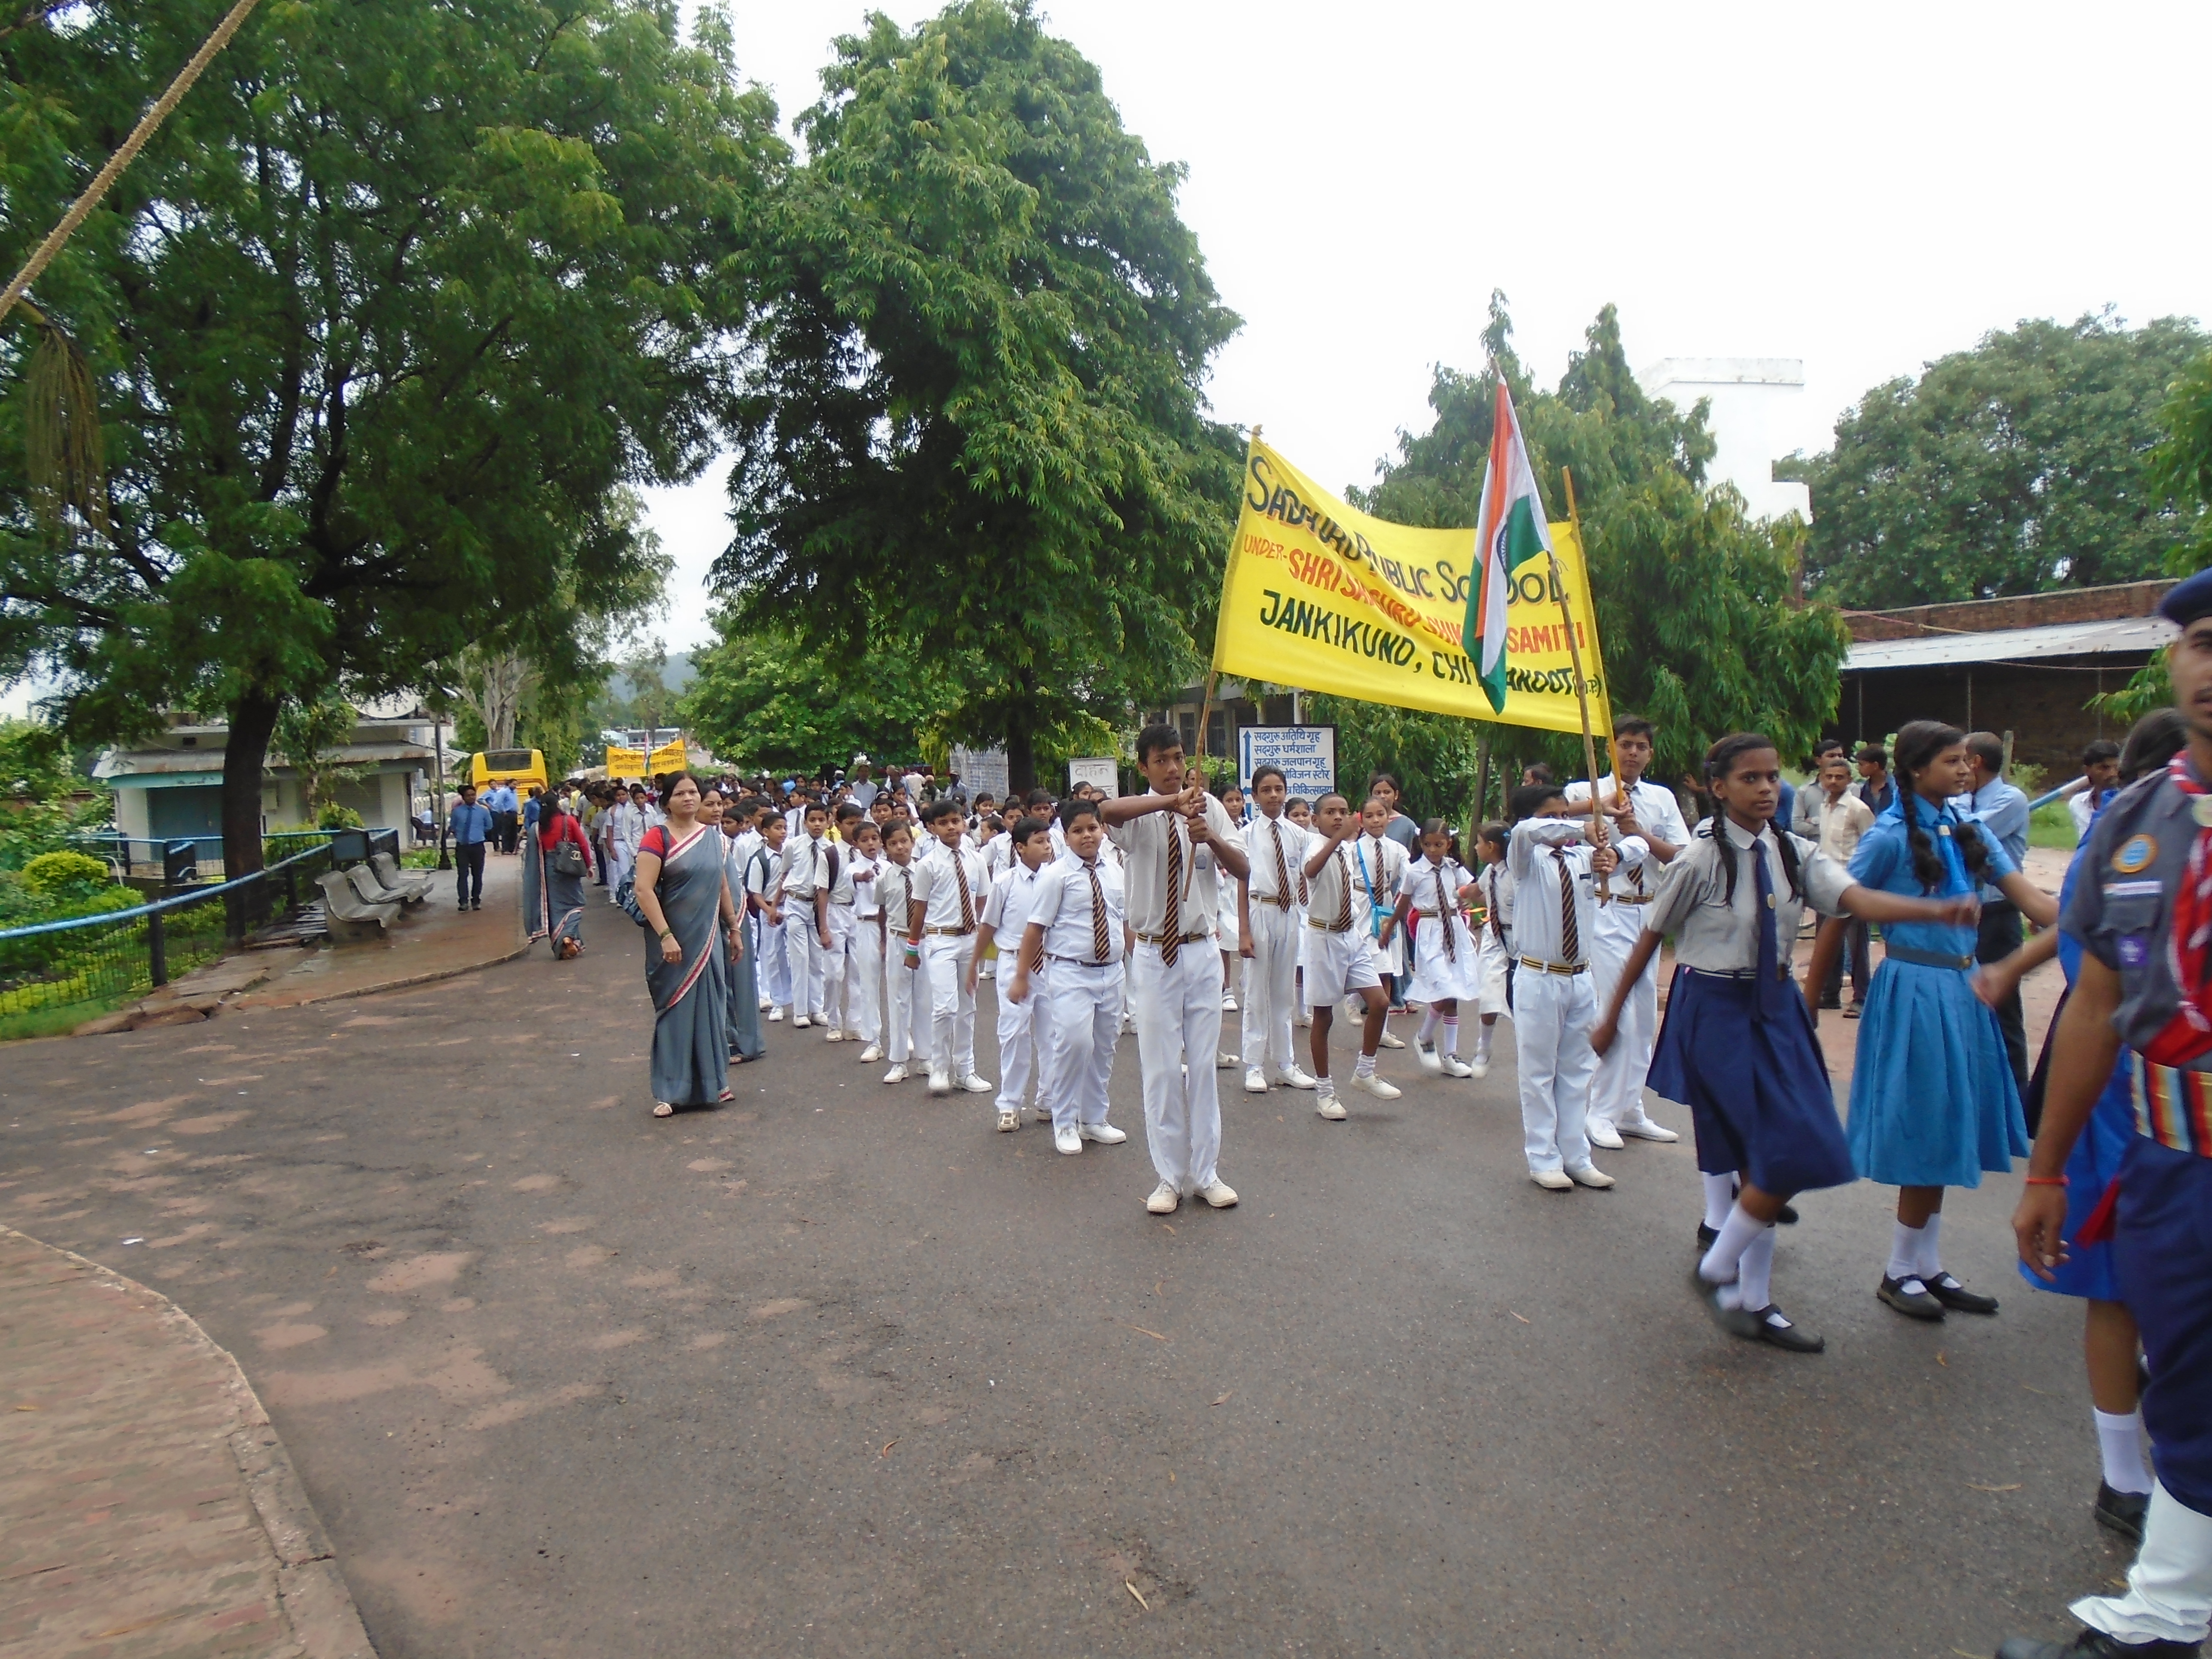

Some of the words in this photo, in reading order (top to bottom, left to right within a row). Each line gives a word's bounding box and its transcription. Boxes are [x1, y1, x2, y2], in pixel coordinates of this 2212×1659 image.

[1289, 548, 1343, 592] SHRI
[1506, 621, 1586, 653] SAMITI
[1281, 728, 1306, 741] अतिथि
[1307, 732, 1322, 743] गृह
[1282, 757, 1312, 766] जलपान
[1312, 757, 1327, 769] गृह
[1313, 768, 1331, 780] स्टोर
